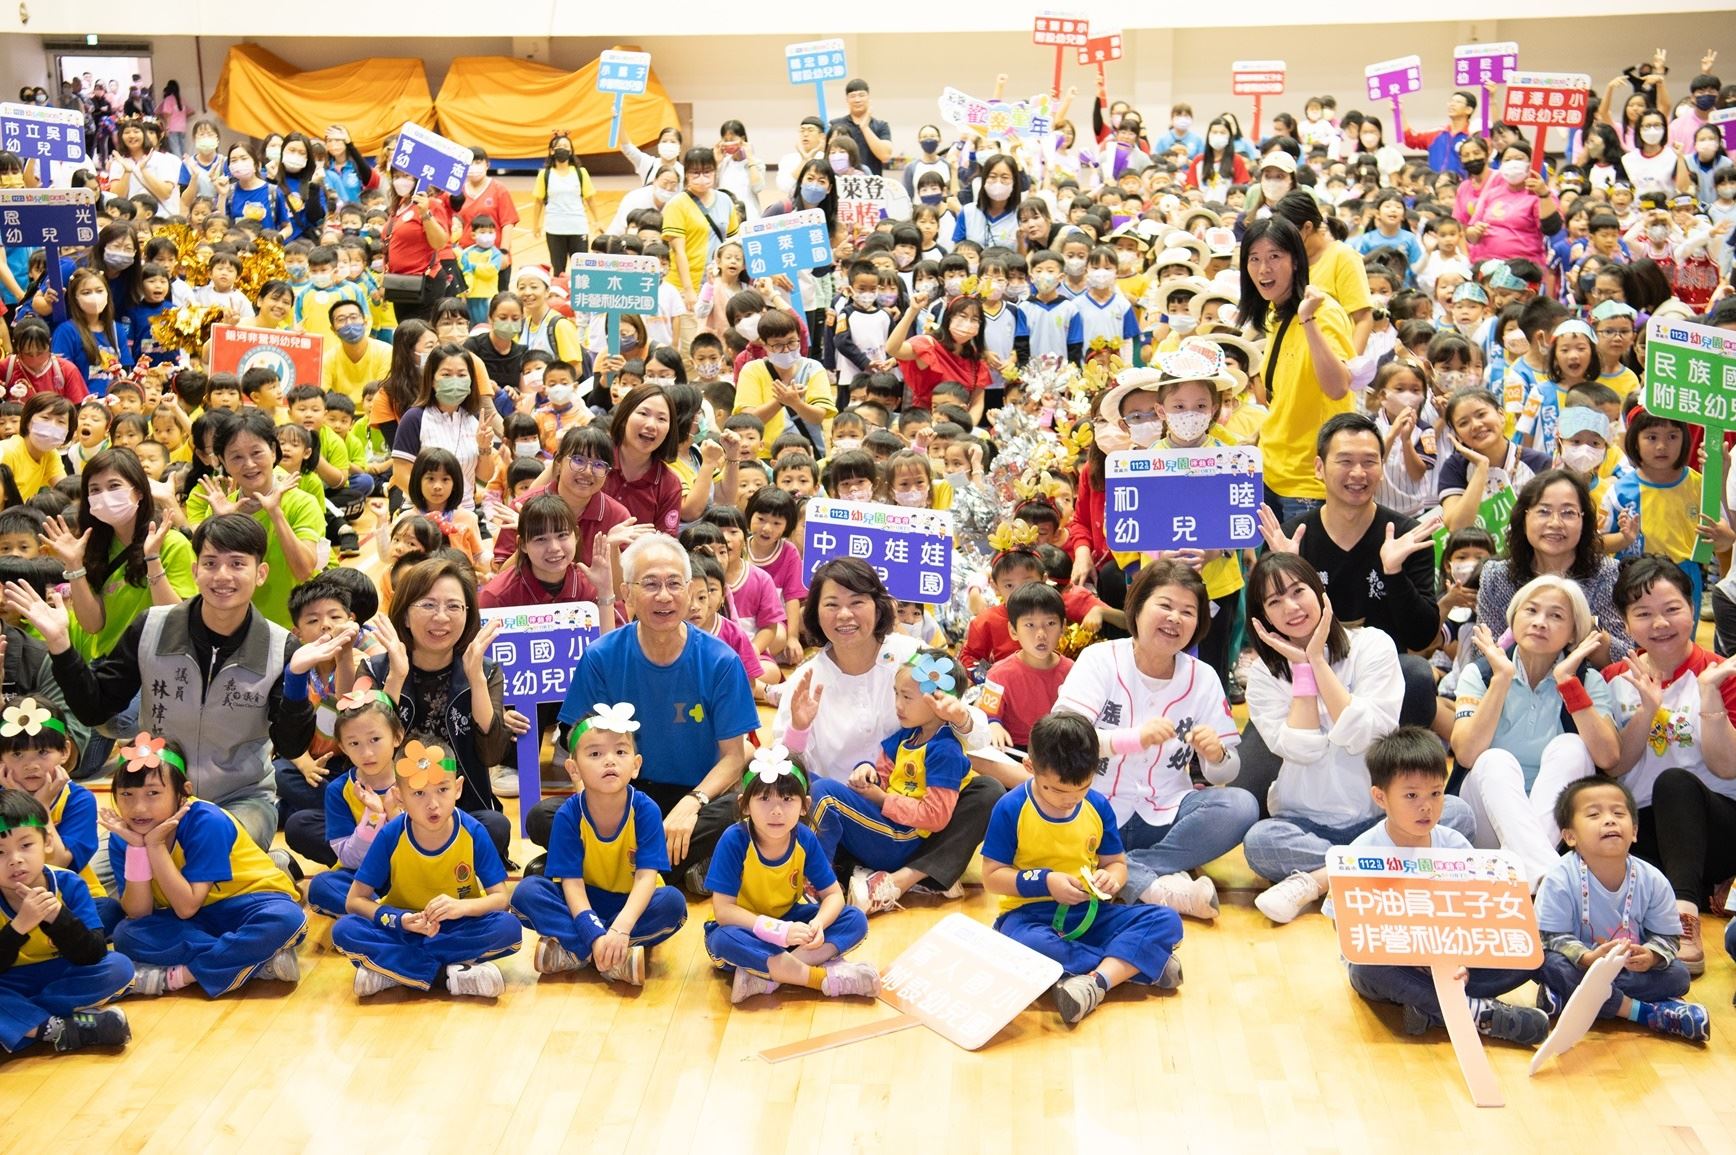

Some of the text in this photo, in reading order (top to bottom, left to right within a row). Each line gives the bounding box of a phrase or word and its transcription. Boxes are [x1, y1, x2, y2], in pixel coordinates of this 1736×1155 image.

[5, 122, 81, 144] 市立吳鳳
[6, 138, 82, 159] 幼兒園
[395, 153, 461, 192] 幼兒園
[838, 202, 881, 227] 最棒
[6, 227, 94, 243] 幼兒園
[747, 229, 825, 257] 貝萊登
[751, 247, 828, 274] 幼兒園
[574, 293, 655, 310] 非營利幼兒園
[1114, 482, 1256, 512] 和睦
[1114, 514, 1256, 543] 幼兒園
[813, 531, 945, 567] 中國娃娃
[503, 667, 577, 696] 幼兒
[1344, 887, 1527, 920] 中油員工子女
[1350, 923, 1534, 957] 非營利幼兒園
